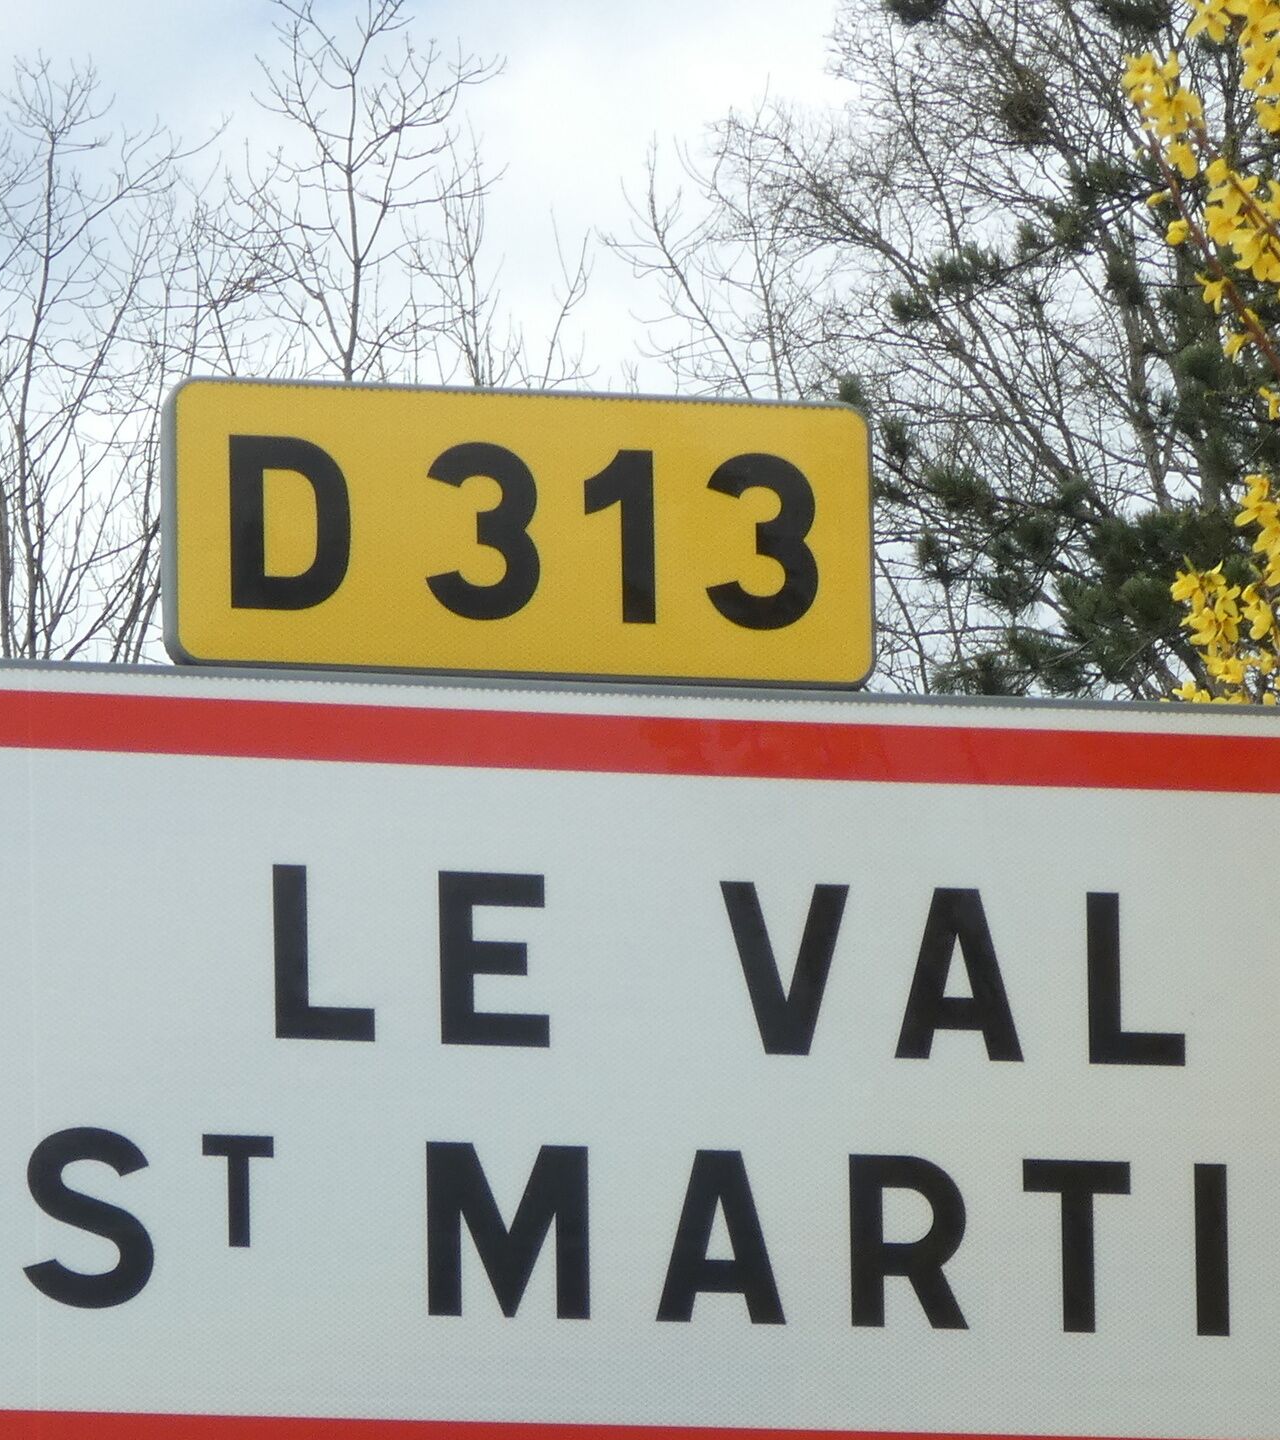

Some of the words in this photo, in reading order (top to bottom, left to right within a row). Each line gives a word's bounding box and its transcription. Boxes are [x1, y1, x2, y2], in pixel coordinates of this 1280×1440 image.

[229, 434, 352, 611] D
[426, 442, 819, 631] 313
[272, 864, 550, 1048] LE
[719, 880, 1186, 1067] VAL
